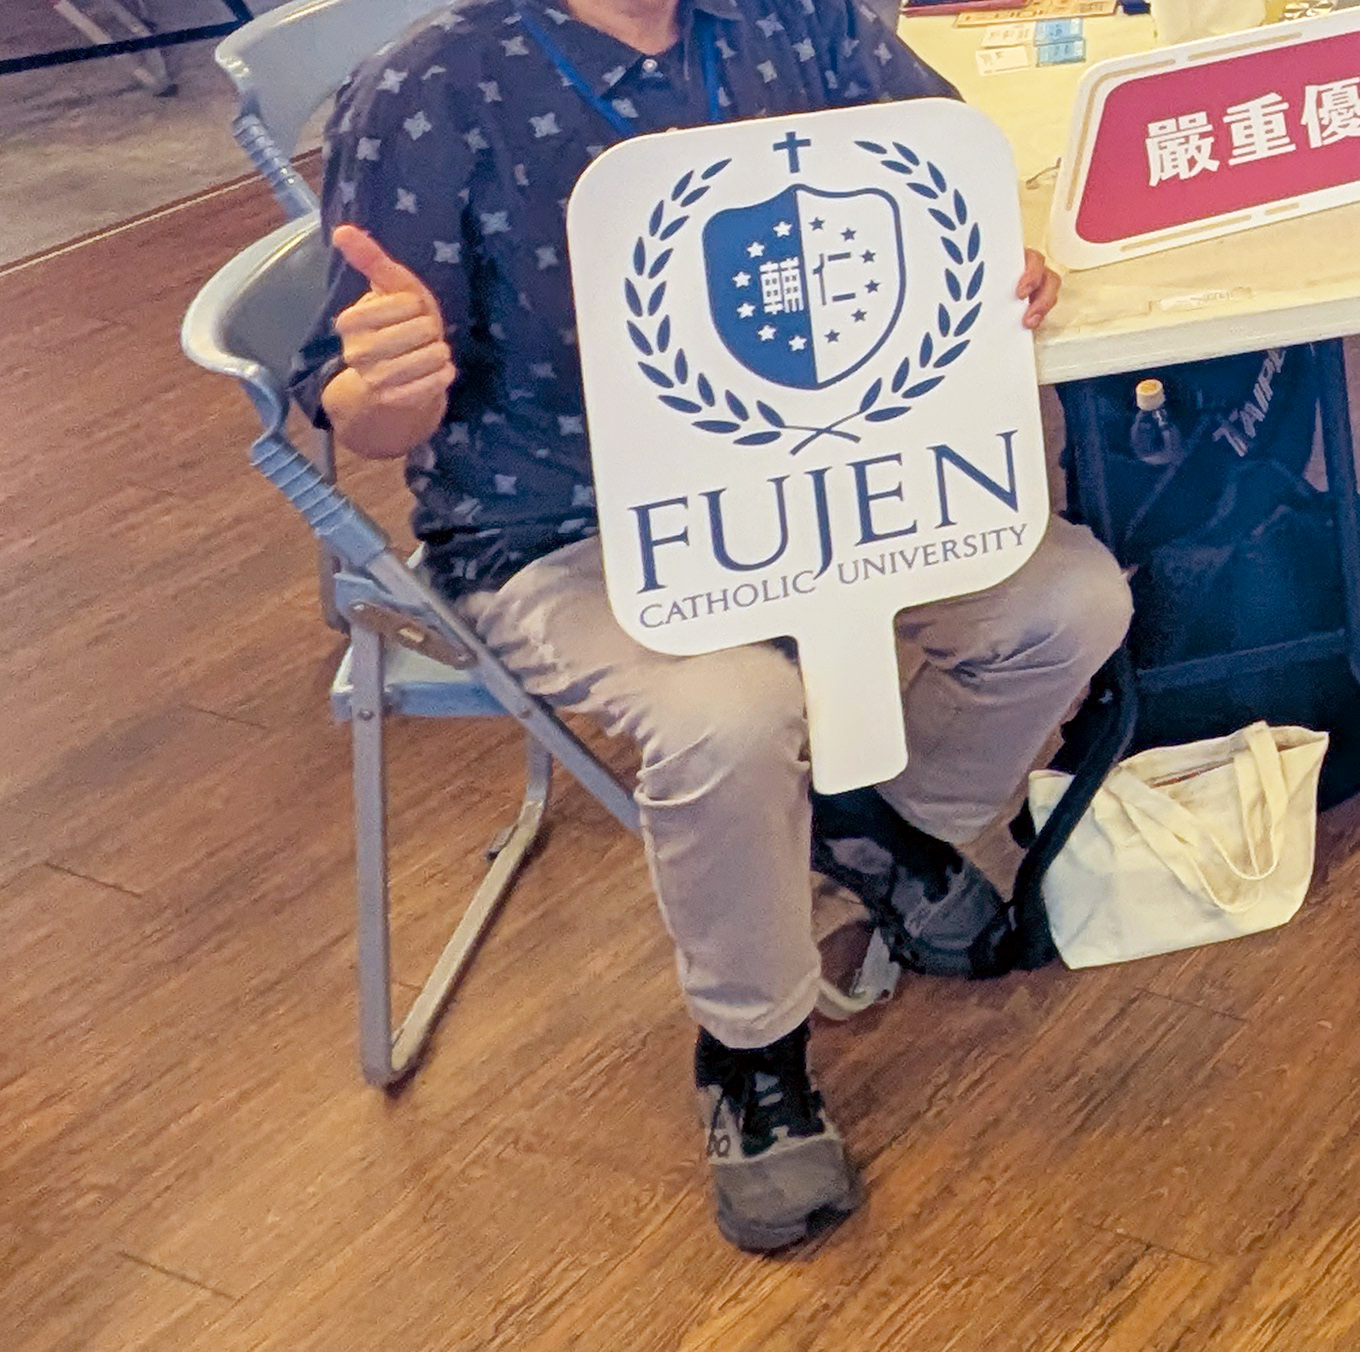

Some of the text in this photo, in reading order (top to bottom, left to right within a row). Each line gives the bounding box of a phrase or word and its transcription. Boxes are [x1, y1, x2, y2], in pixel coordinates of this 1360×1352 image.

[629, 428, 1020, 595] FUJEN
[639, 524, 1029, 630] CATHOLIC UNIVERSITY
